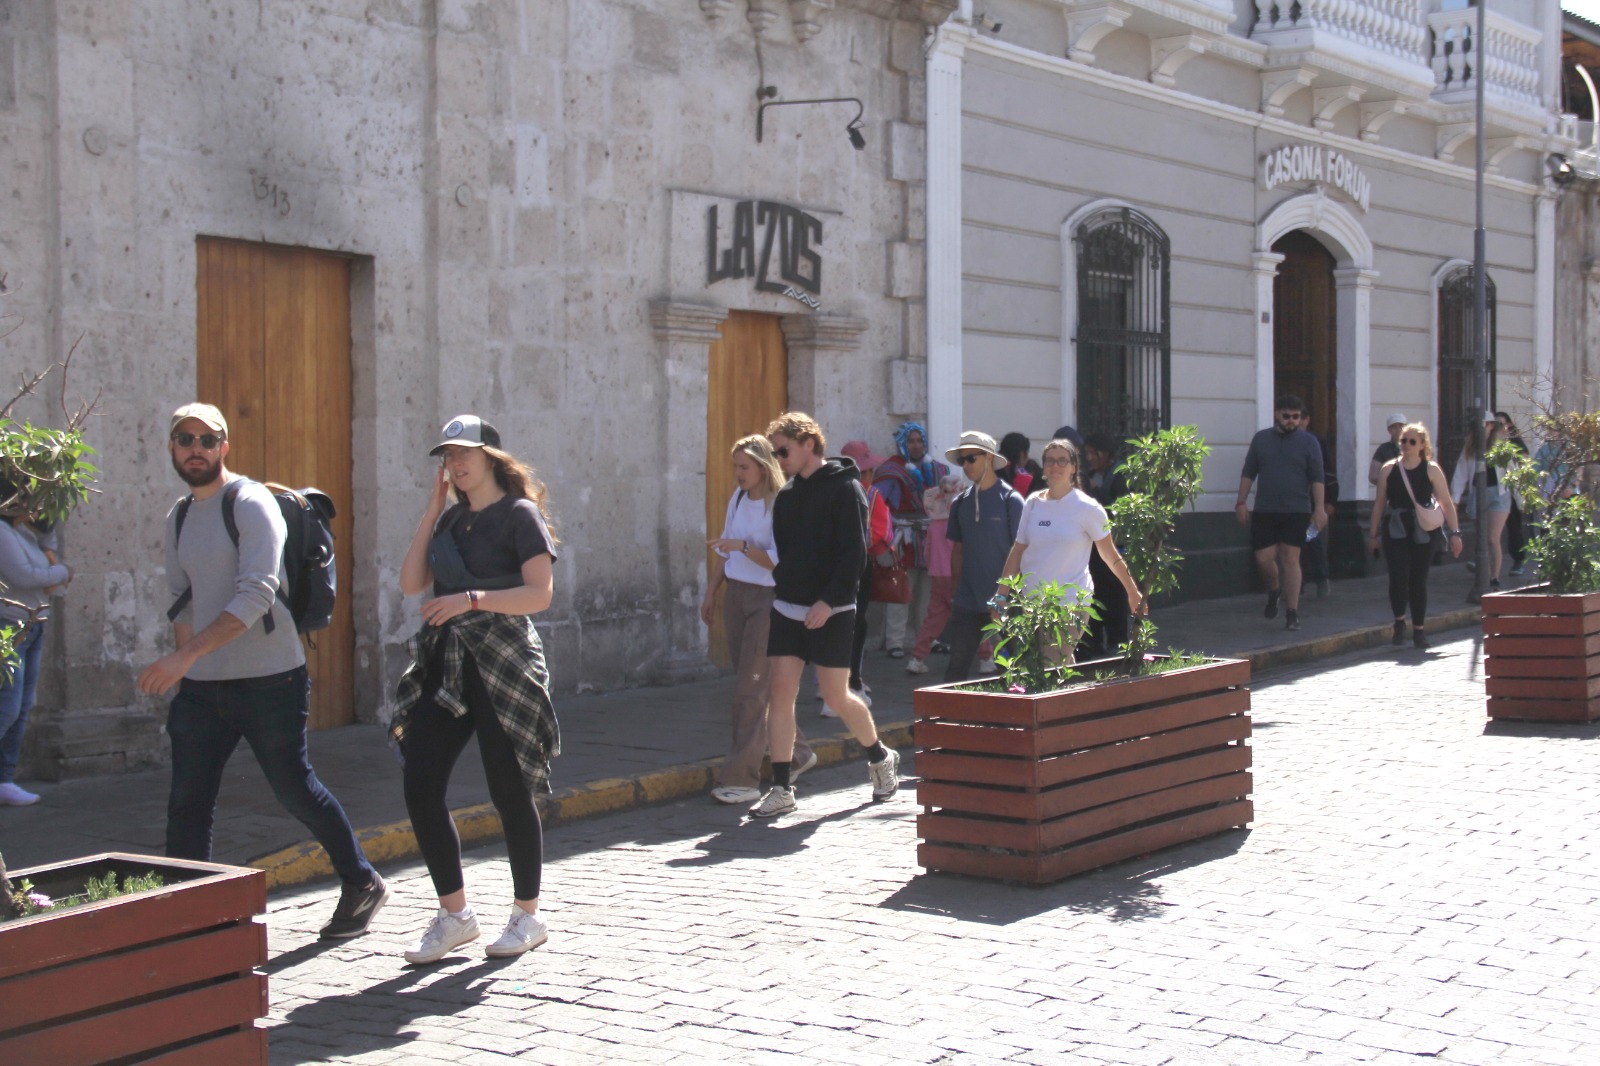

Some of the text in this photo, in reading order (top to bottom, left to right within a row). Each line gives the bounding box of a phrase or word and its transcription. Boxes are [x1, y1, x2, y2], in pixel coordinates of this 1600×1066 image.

[1265, 146, 1371, 213] CASONA FORUM
[707, 200, 822, 296] LAZOS
